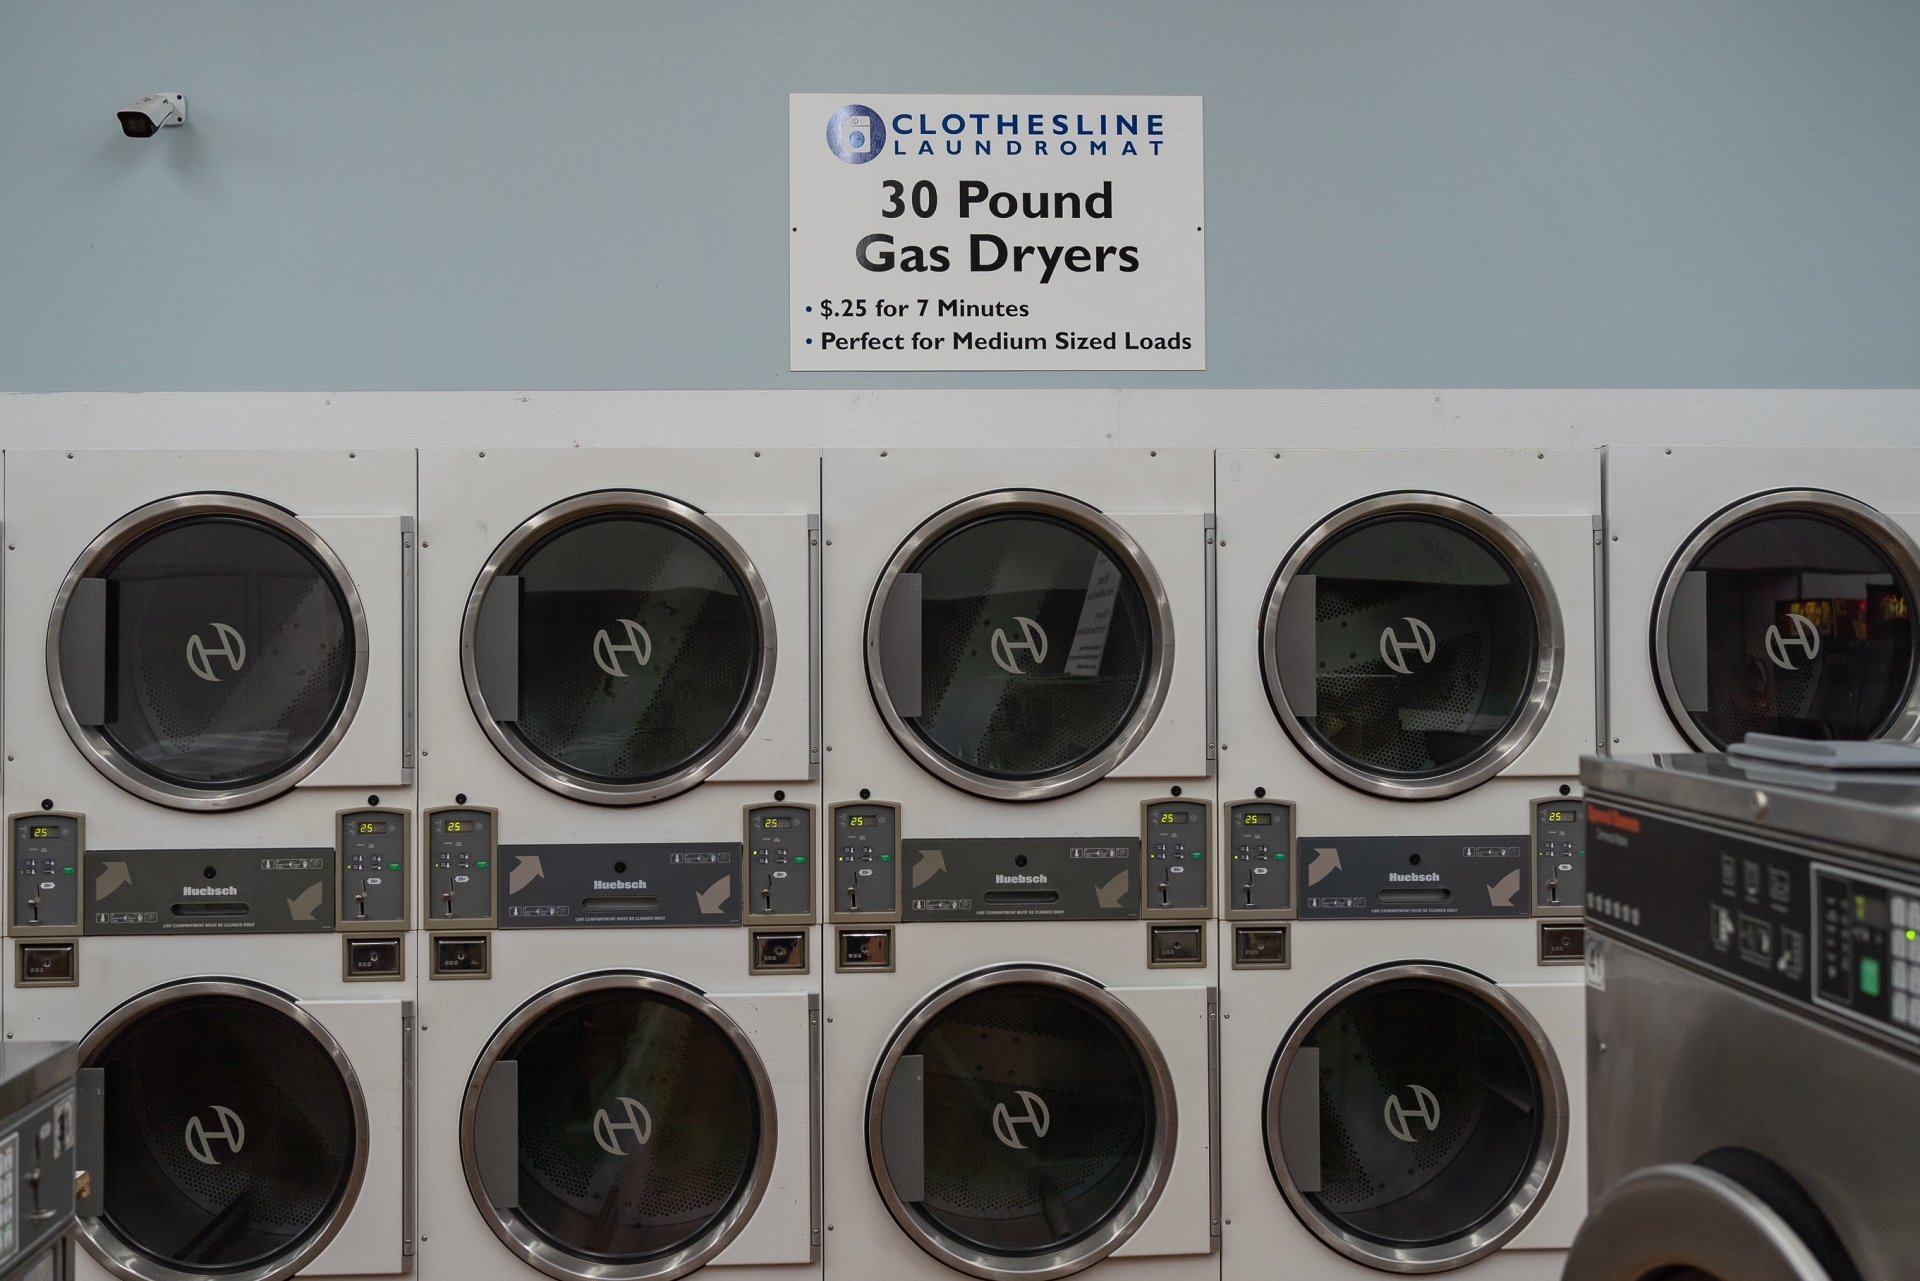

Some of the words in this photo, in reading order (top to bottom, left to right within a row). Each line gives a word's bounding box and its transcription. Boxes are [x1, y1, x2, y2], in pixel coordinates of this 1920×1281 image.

[892, 113, 1164, 136] CLOTHESLINE
[894, 140, 1164, 156] LAUNDROMAT
[881, 179, 938, 219] 30
[959, 180, 1113, 219] Pound
[855, 233, 951, 273] Gas
[969, 233, 1140, 284] Dryers
[820, 299, 867, 319] $.25
[875, 299, 910, 318] for
[916, 299, 928, 317] 7
[938, 299, 1030, 318] Minutes
[821, 331, 905, 350] Perfect
[911, 331, 946, 350] for
[953, 331, 1047, 350] Medium
[1055, 331, 1116, 350] Sized
[1125, 331, 1192, 350] Loads
[593, 880, 647, 889] Huebsch
[995, 874, 1048, 884] Huebsch
[1389, 873, 1440, 881] Huebsch
[183, 886, 238, 896] Huebsch
